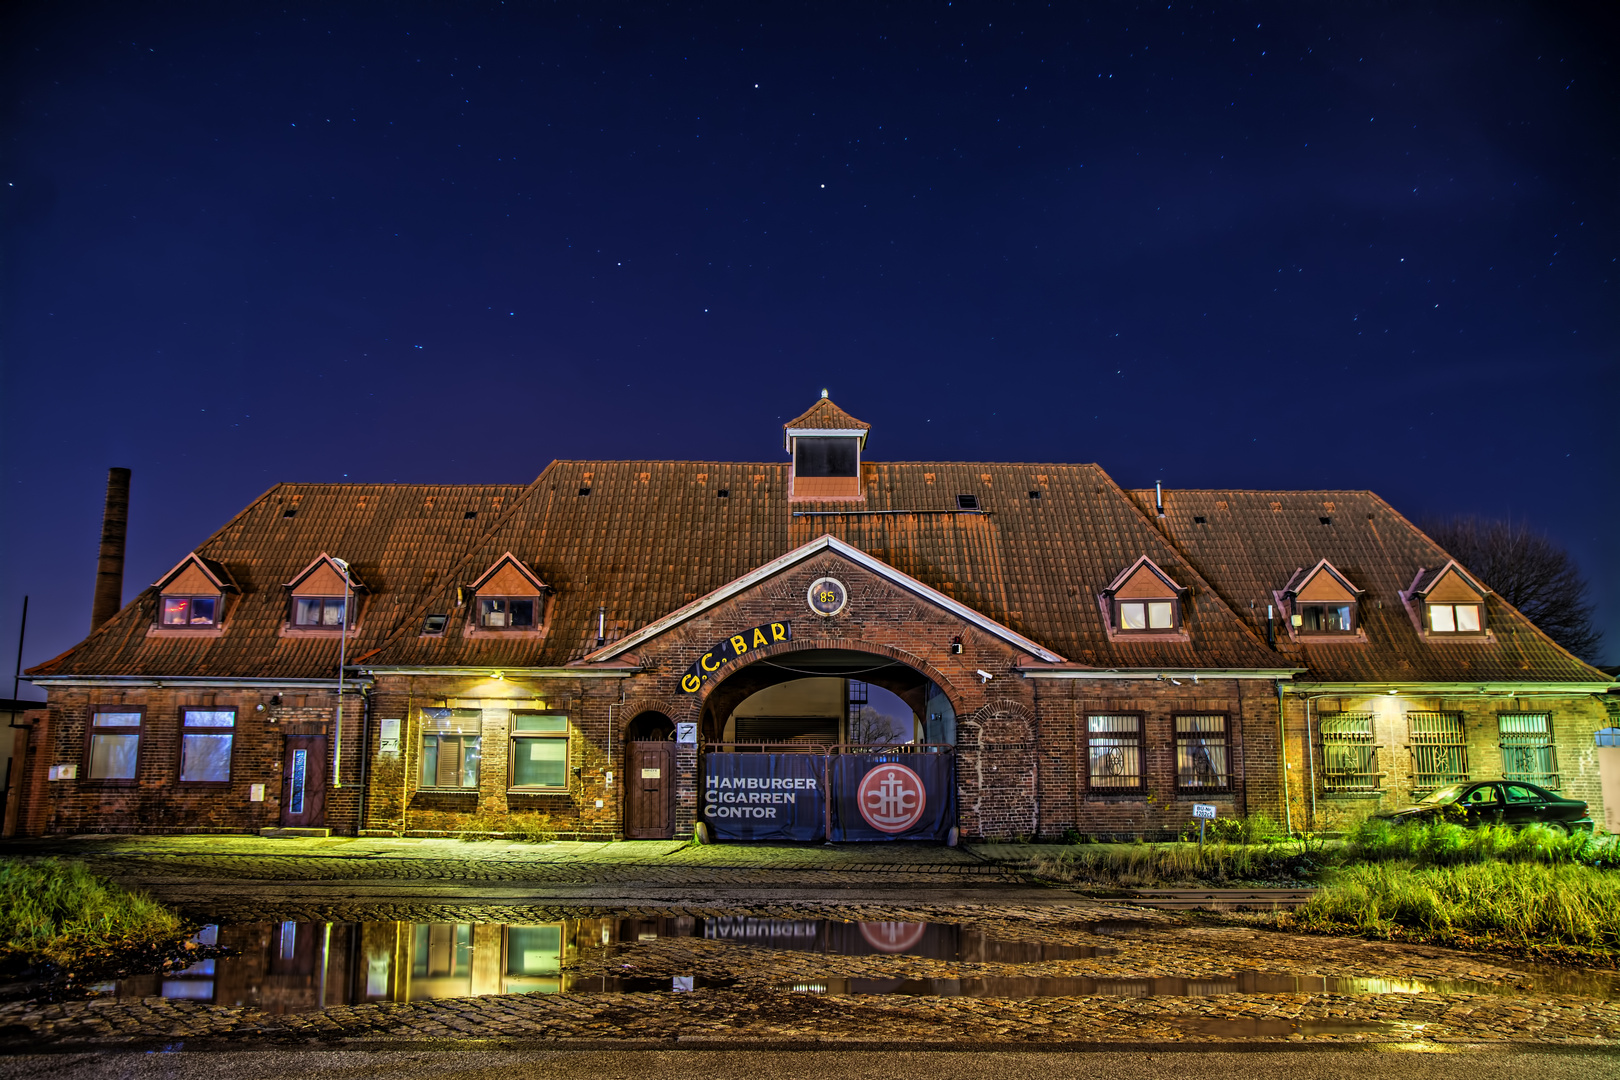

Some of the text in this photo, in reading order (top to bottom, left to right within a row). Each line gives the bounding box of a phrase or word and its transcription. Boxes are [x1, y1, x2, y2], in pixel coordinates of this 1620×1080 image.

[820, 591, 835, 603] 85
[730, 622, 787, 655] BAR
[680, 724, 694, 740] 7
[706, 775, 817, 790] HAMBURGER
[704, 789, 796, 804] CIGARREN
[704, 804, 777, 819] CONTOR
